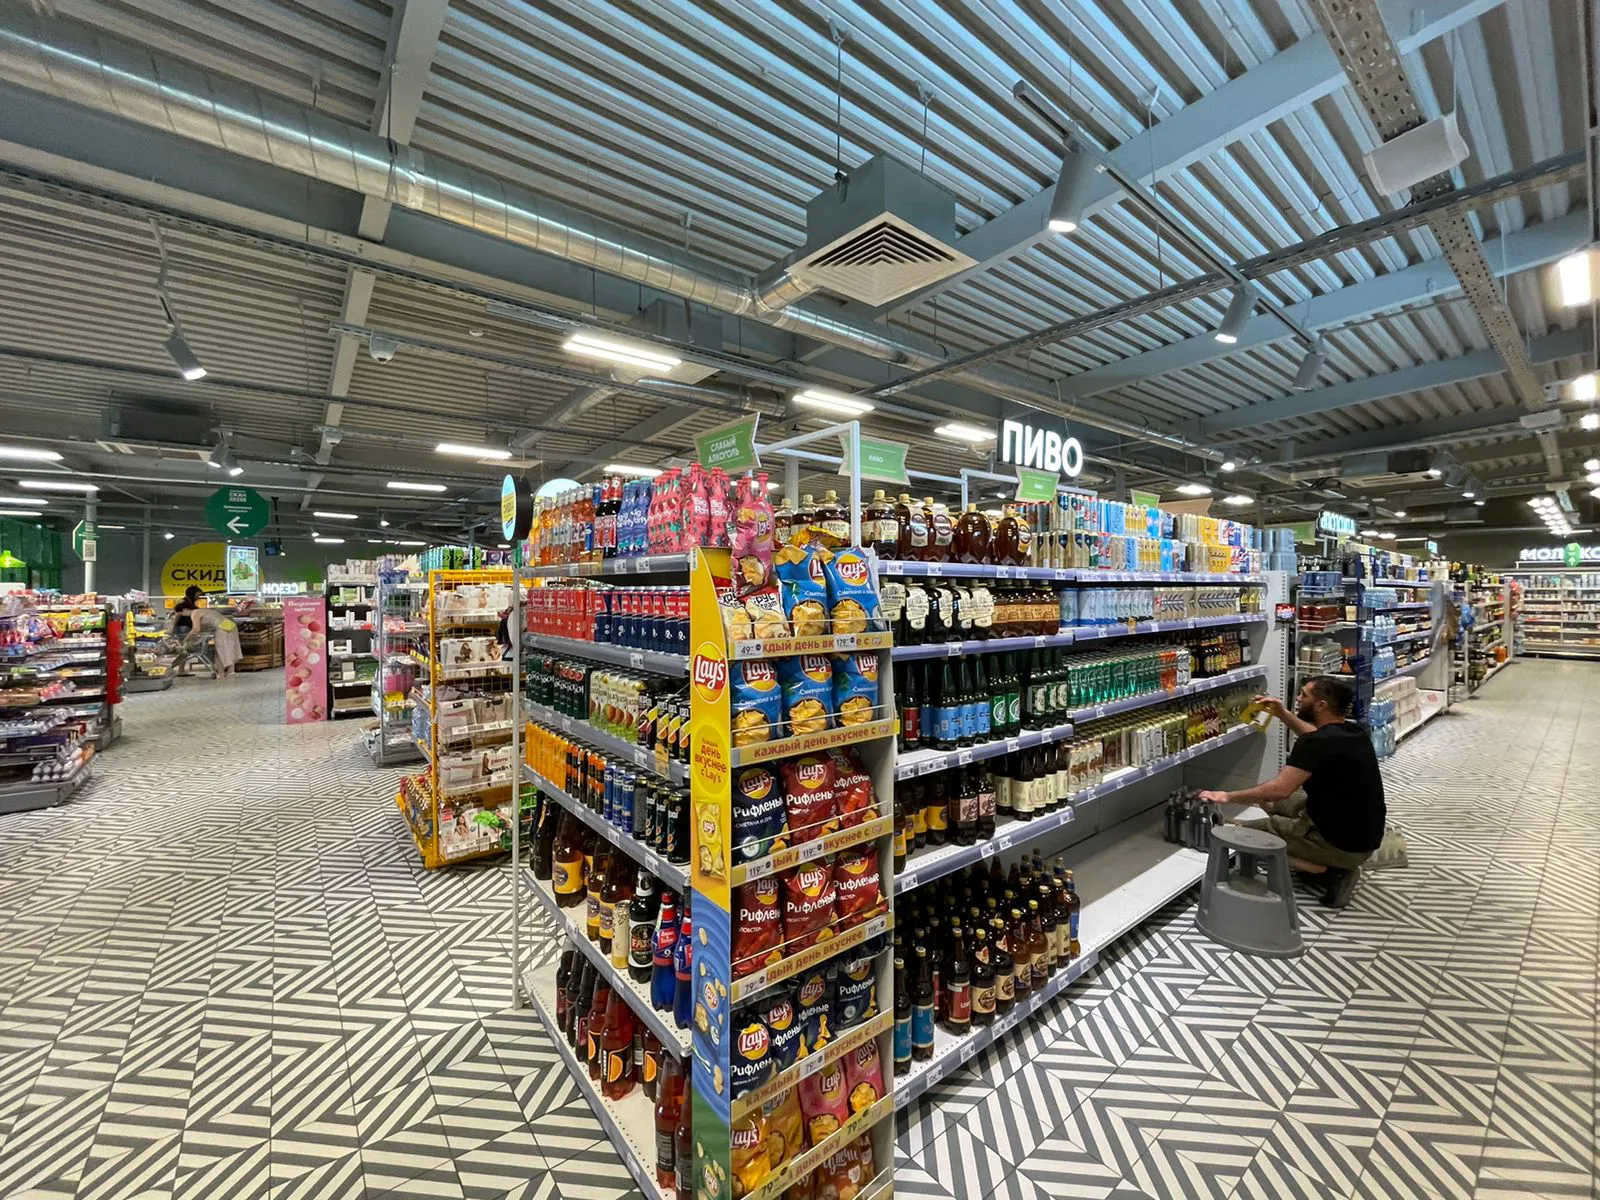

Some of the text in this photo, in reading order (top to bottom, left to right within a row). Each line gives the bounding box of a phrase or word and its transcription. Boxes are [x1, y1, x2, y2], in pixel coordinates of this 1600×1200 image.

[710, 434, 737, 452] СЛАБЫЙ
[1003, 419, 1083, 477] ПИВО
[707, 447, 740, 463] АЛКОГОЛЬ
[1519, 547, 1600, 561] МОЛКО
[171, 569, 226, 583] СКИД
[794, 638, 820, 651] день
[695, 655, 725, 689] Lay's
[803, 735, 828, 750] день
[831, 729, 869, 743] вкуснее
[702, 745, 720, 759] день
[695, 754, 727, 773] вкуснее
[799, 764, 824, 780] Lay's
[733, 796, 783, 818] Рифлены
[824, 831, 862, 849] вкуснее
[800, 870, 824, 889] Lay's
[740, 908, 781, 923] Рифлен
[768, 931, 864, 981] дый день вкуснее
[741, 1030, 768, 1052] Lay's
[824, 1031, 863, 1060] вкуснее
[731, 1058, 772, 1077] Рифлен
